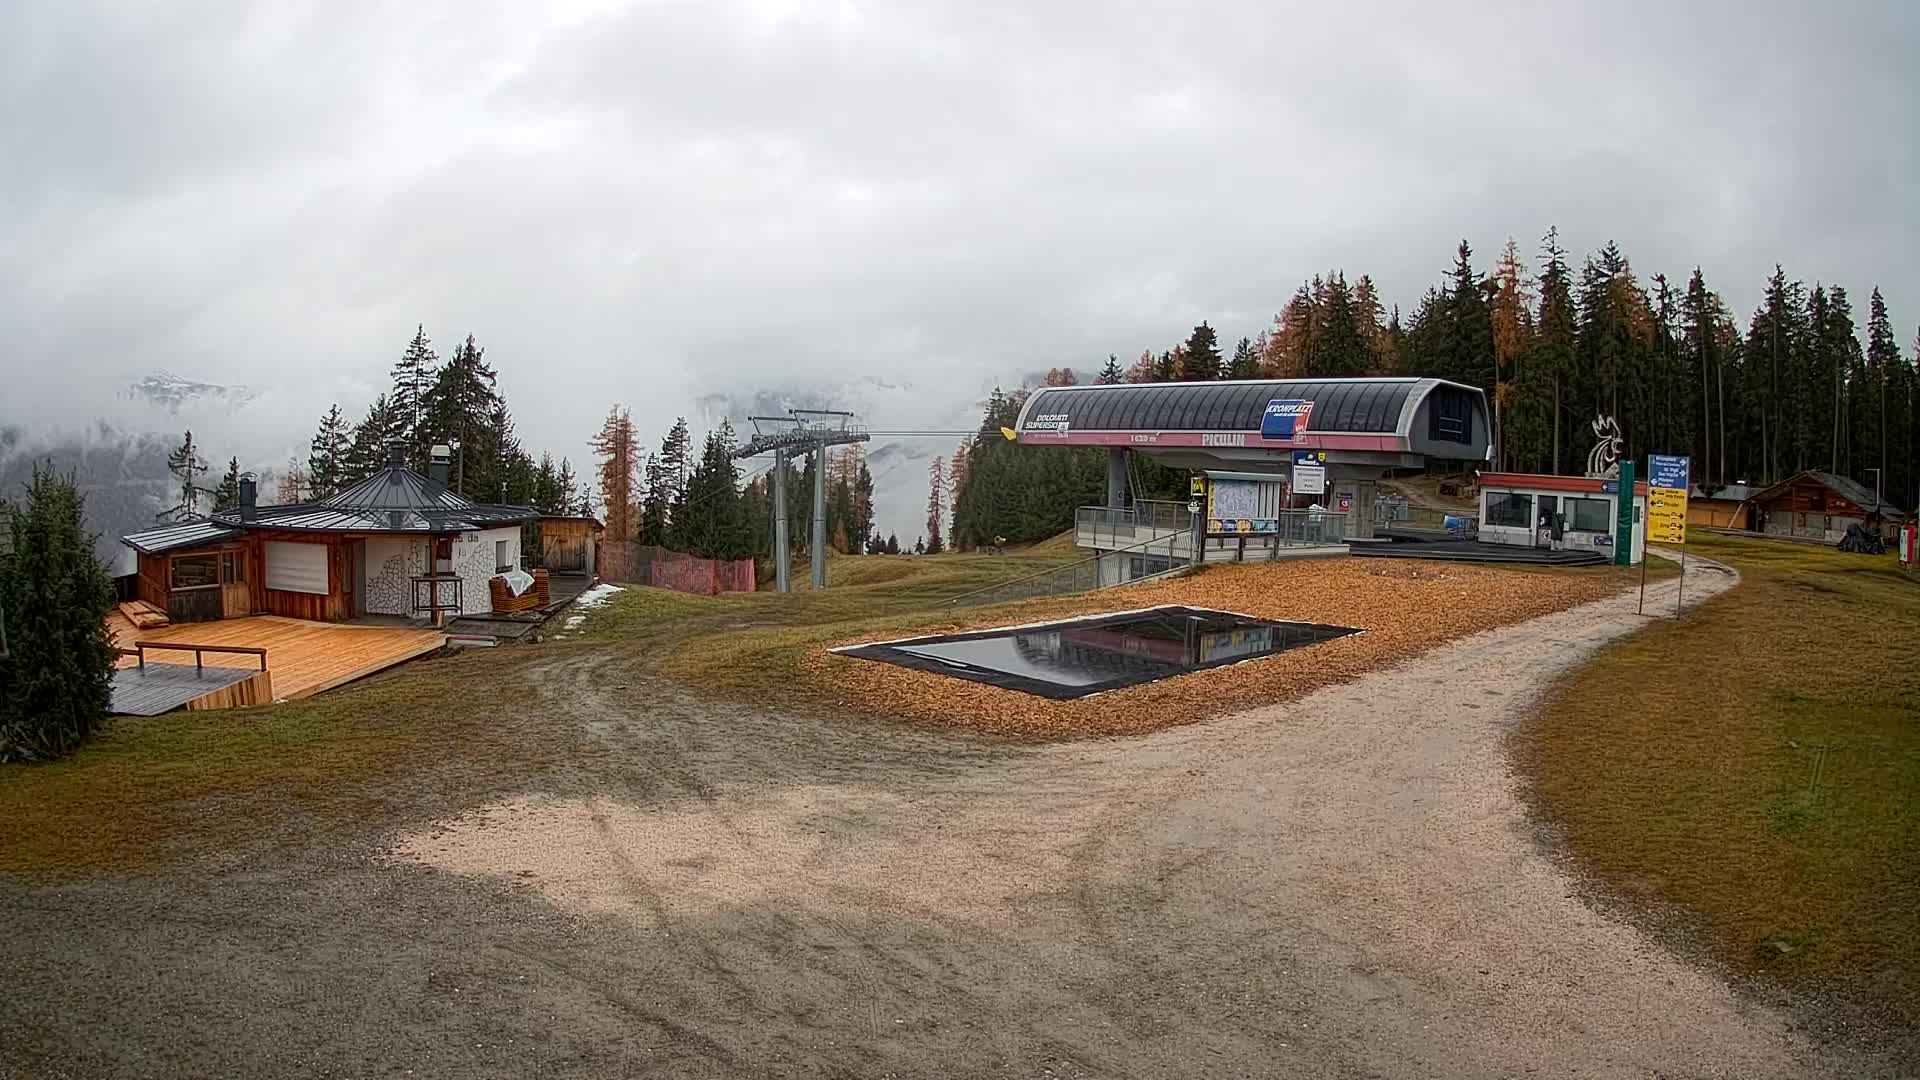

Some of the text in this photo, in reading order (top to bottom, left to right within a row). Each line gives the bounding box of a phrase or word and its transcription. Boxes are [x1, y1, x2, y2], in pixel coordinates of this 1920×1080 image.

[1266, 403, 1312, 413] KRONPLATZ
[1025, 421, 1058, 429] SUPERSKI
[1202, 433, 1245, 447] PICULIN
